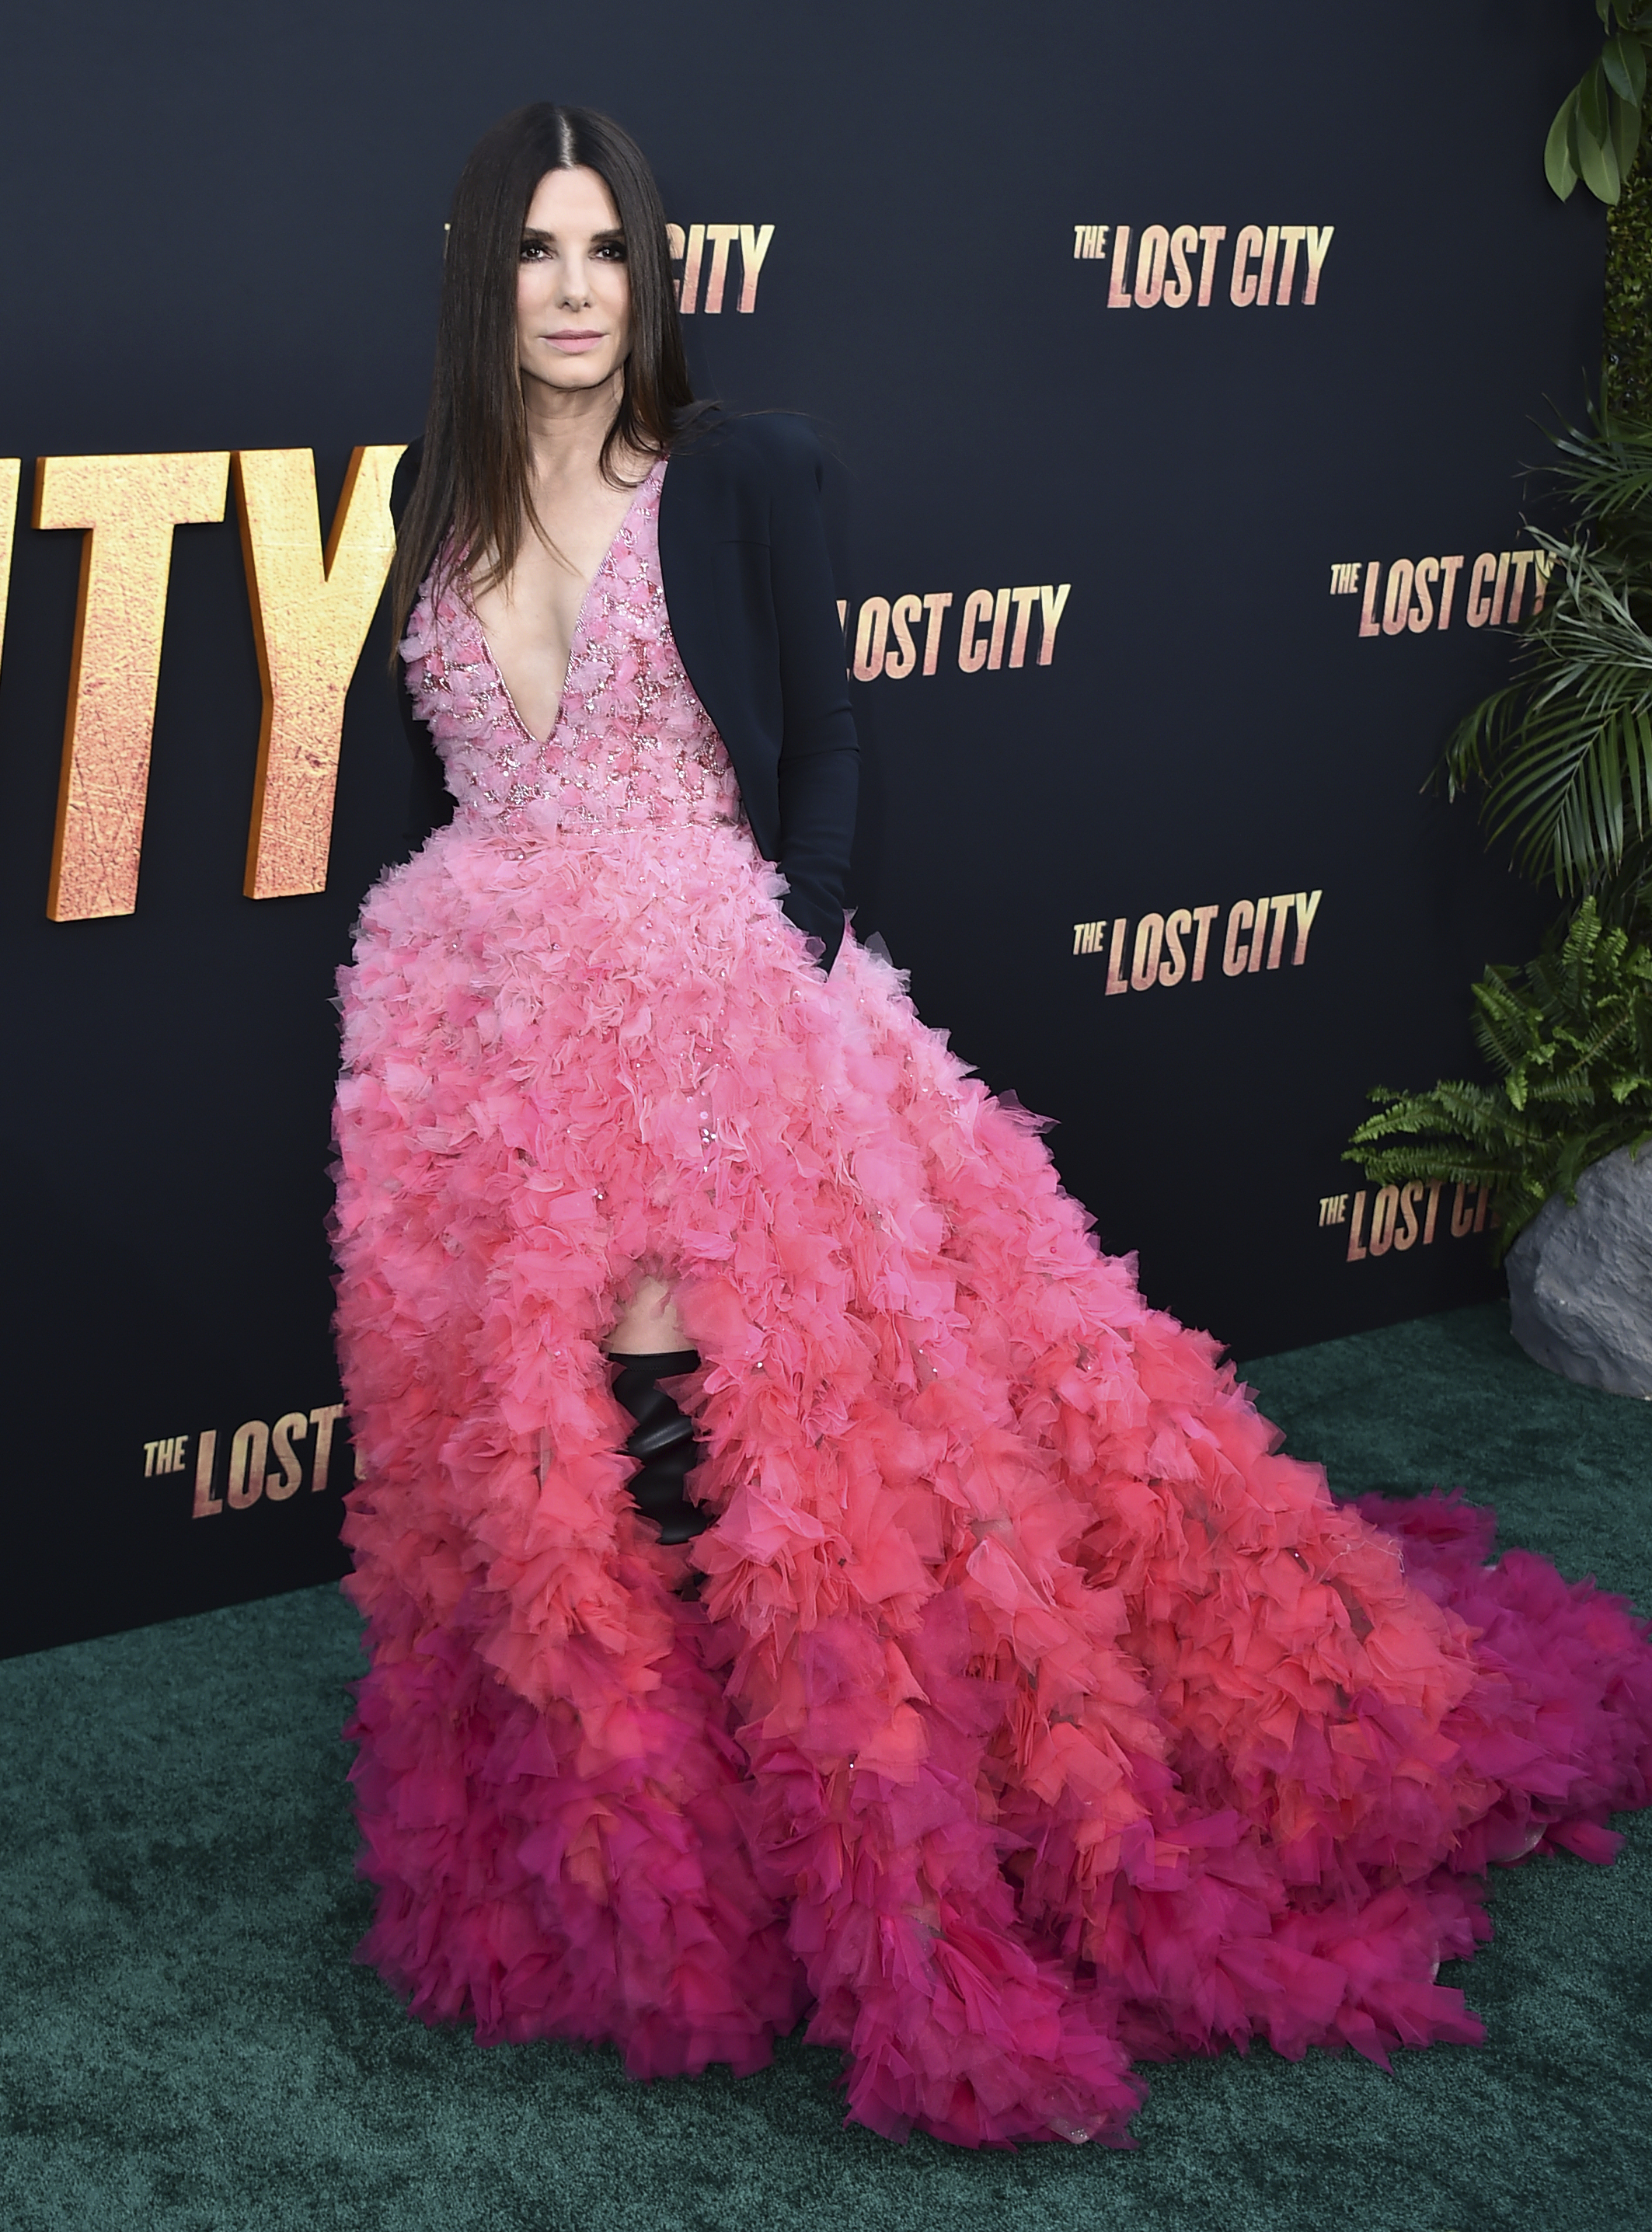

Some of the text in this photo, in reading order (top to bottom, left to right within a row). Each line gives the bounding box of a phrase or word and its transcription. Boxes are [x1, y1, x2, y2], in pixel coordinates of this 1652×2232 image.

[1074, 225, 1334, 309] THE LOST CITY
[836, 584, 1071, 682] OST CITY
[1330, 549, 1556, 637] THE LOST CITY
[0, 445, 409, 922] TY
[1073, 890, 1323, 996] THE LOST CITY
[1319, 1194, 1348, 1226] THE
[1347, 1179, 1443, 1262] LOST
[143, 1435, 189, 1477] THE
[192, 1403, 344, 1519] LOST
